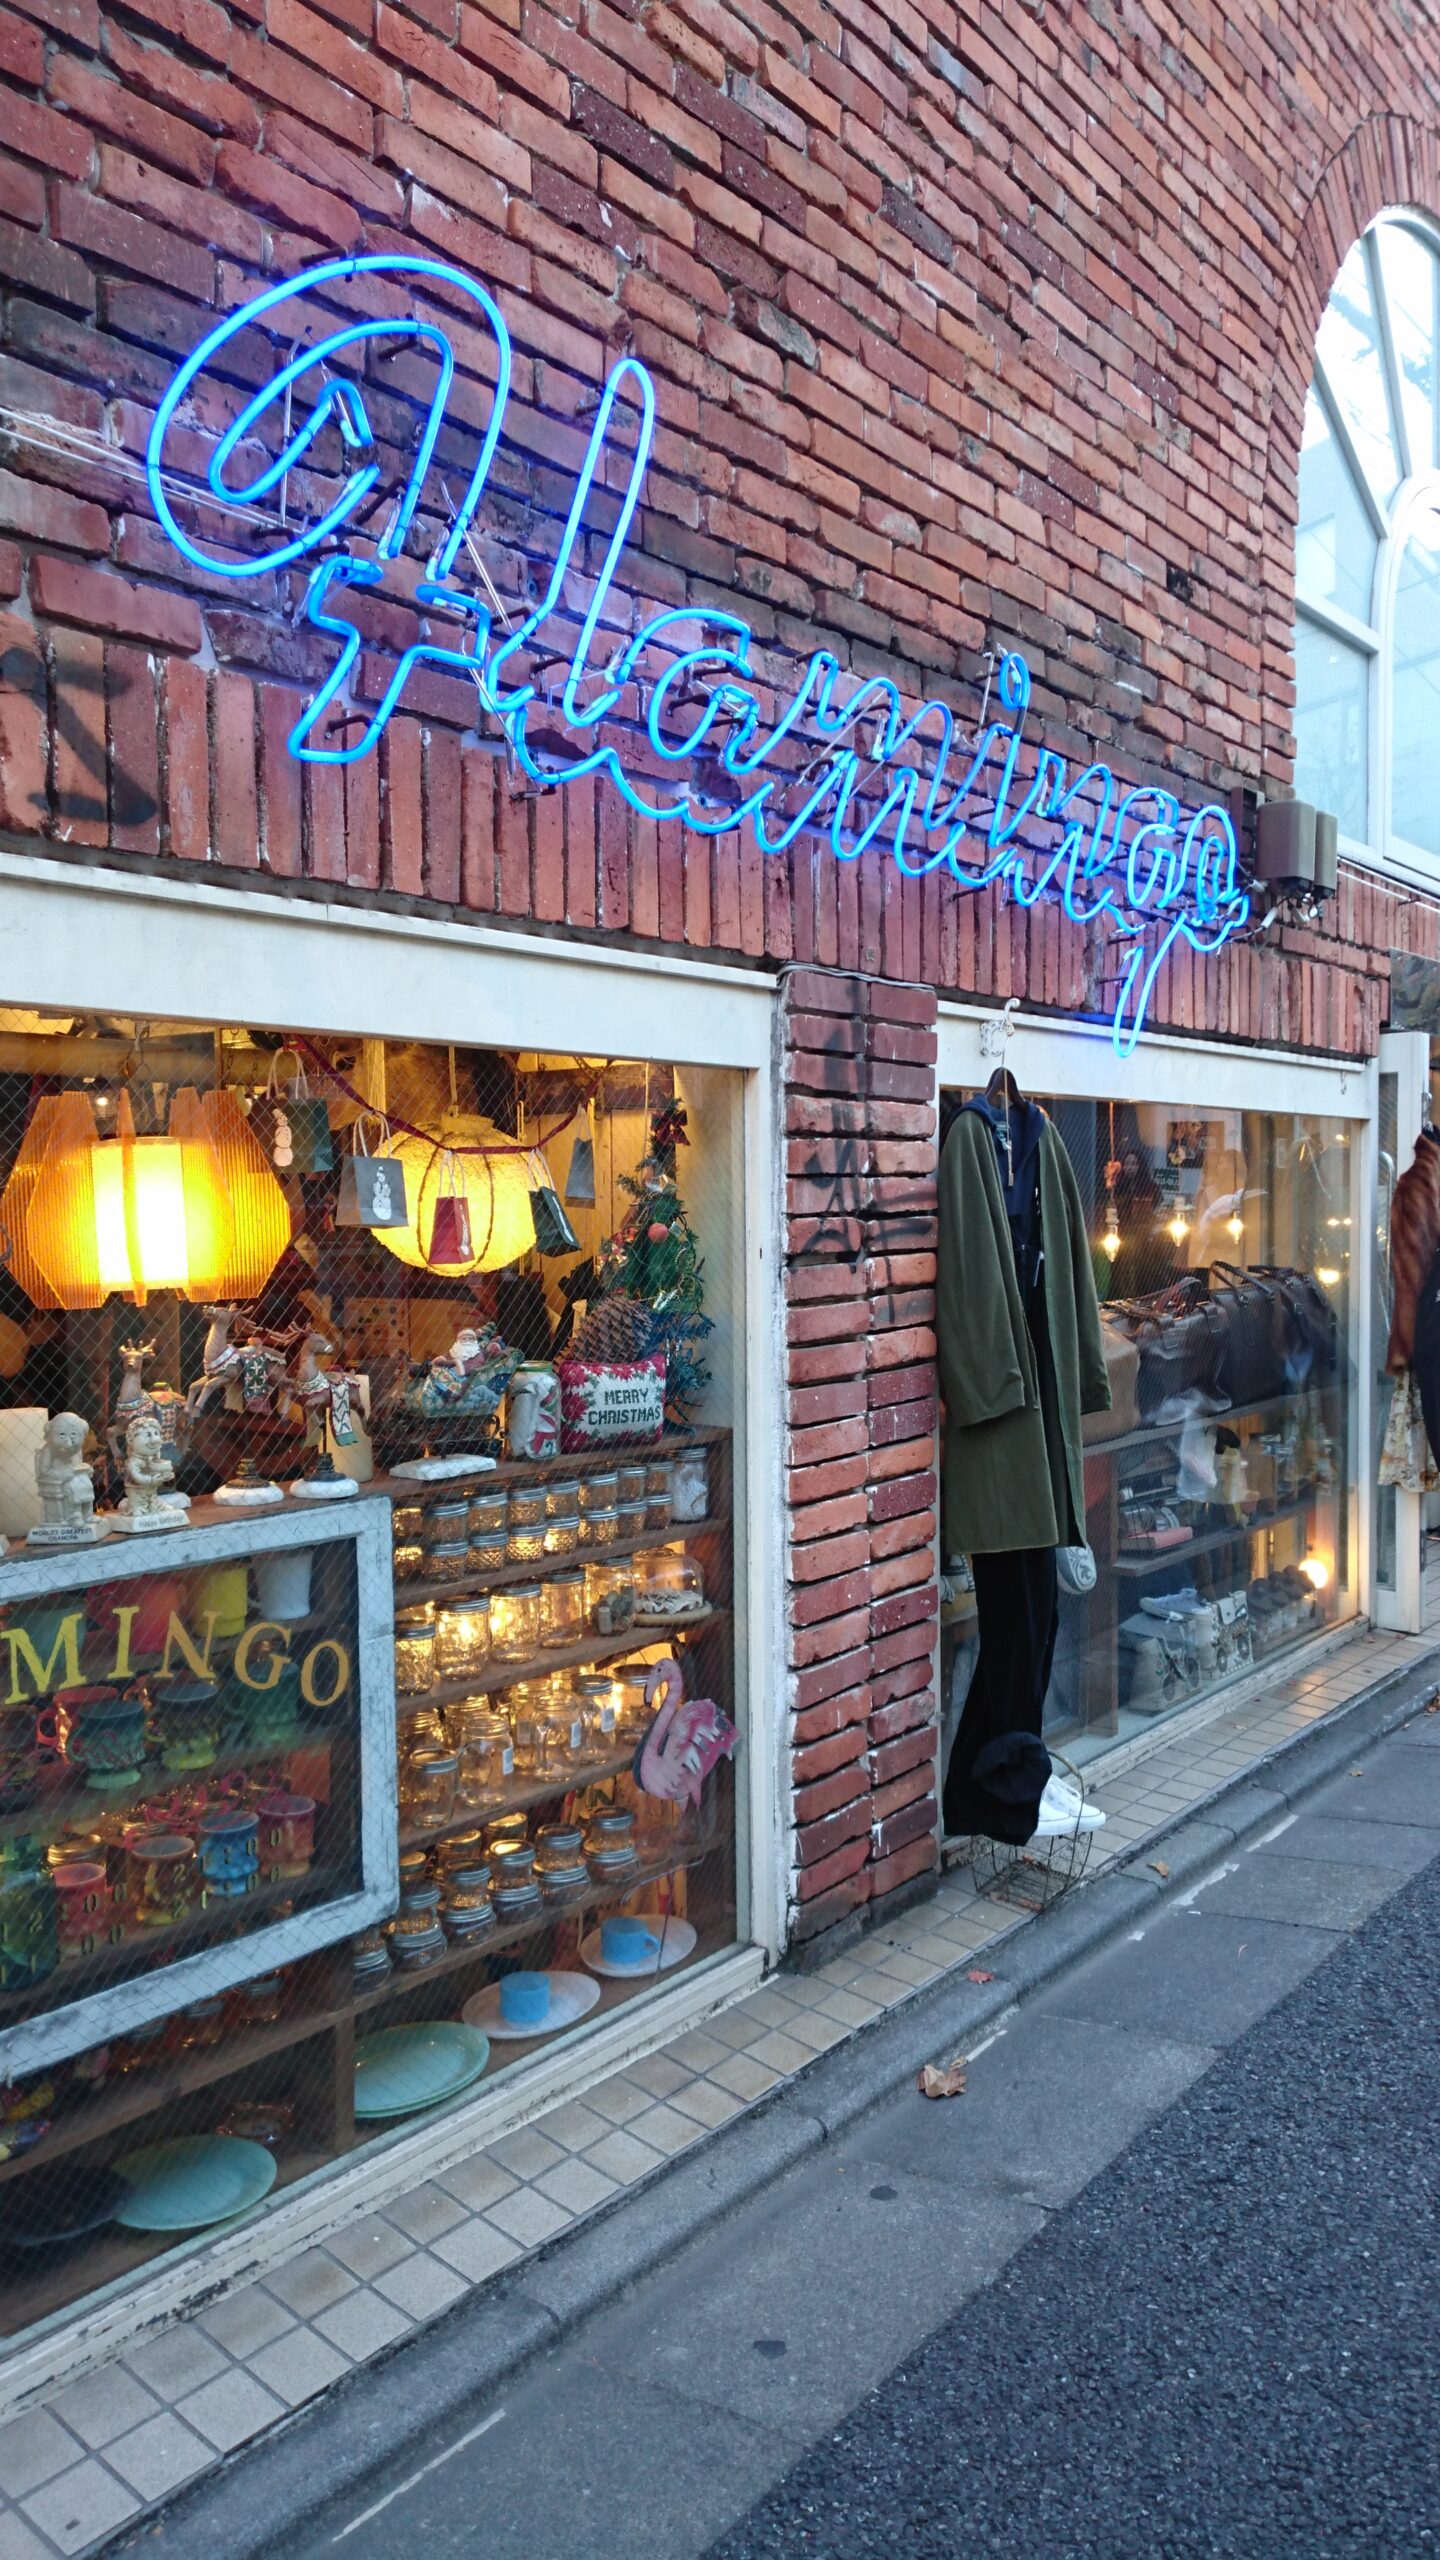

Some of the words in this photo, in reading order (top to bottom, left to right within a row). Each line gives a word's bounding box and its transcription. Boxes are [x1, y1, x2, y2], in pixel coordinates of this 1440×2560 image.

[148, 255, 1250, 1058] Flamingo
[588, 1406, 661, 1425] CHRISTMAS
[604, 1388, 648, 1405] MERRY
[0, 1606, 349, 1706] MINGO
